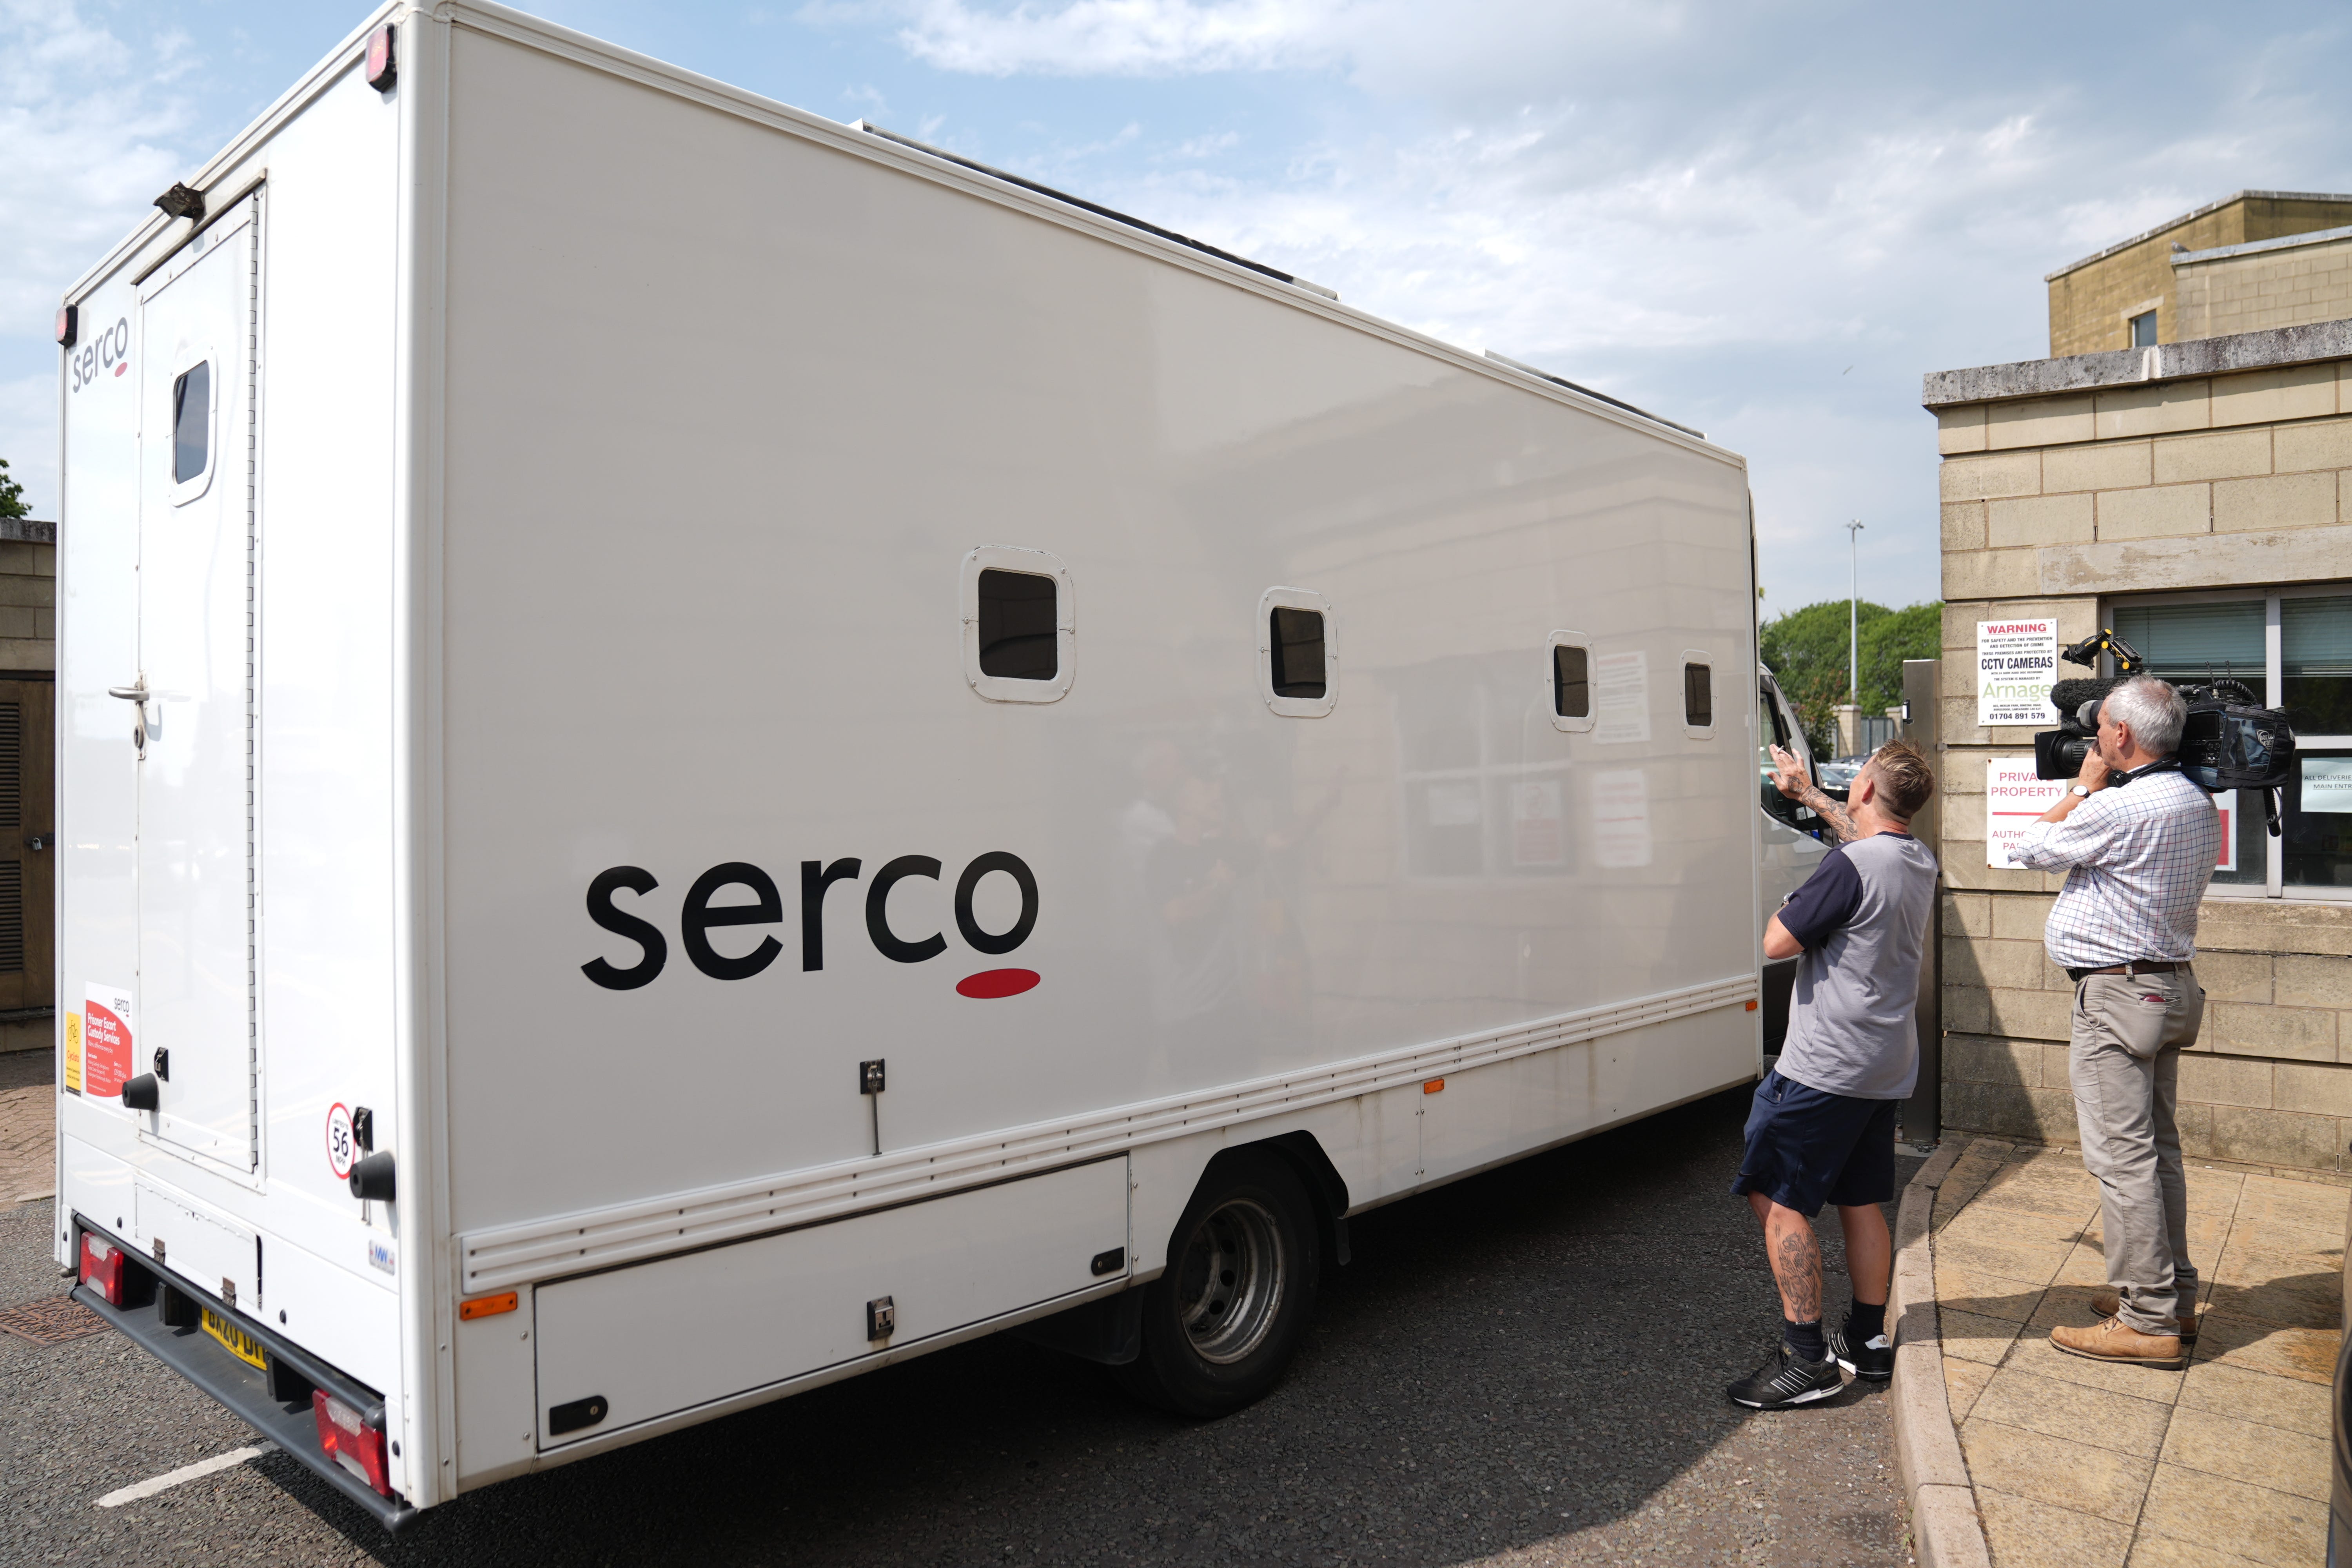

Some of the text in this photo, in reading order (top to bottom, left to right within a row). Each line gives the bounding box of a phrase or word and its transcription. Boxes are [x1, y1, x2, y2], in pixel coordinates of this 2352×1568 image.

[73, 317, 128, 393] serco
[1987, 623, 2047, 634] WARNING
[1982, 657, 2053, 670] CCTV CAMERAS
[1982, 682, 2053, 702] Arnage
[2000, 772, 2054, 781] PRIVA
[1991, 787, 2063, 796] PROPERTY
[581, 851, 1039, 991] serco
[114, 998, 129, 1013] serco
[88, 1012, 116, 1032] Prisoner Escort
[88, 1025, 120, 1045] Custody Services
[67, 1050, 79, 1062] Cyclists
[334, 1127, 348, 1157] 56
[336, 1154, 346, 1167] MPH
